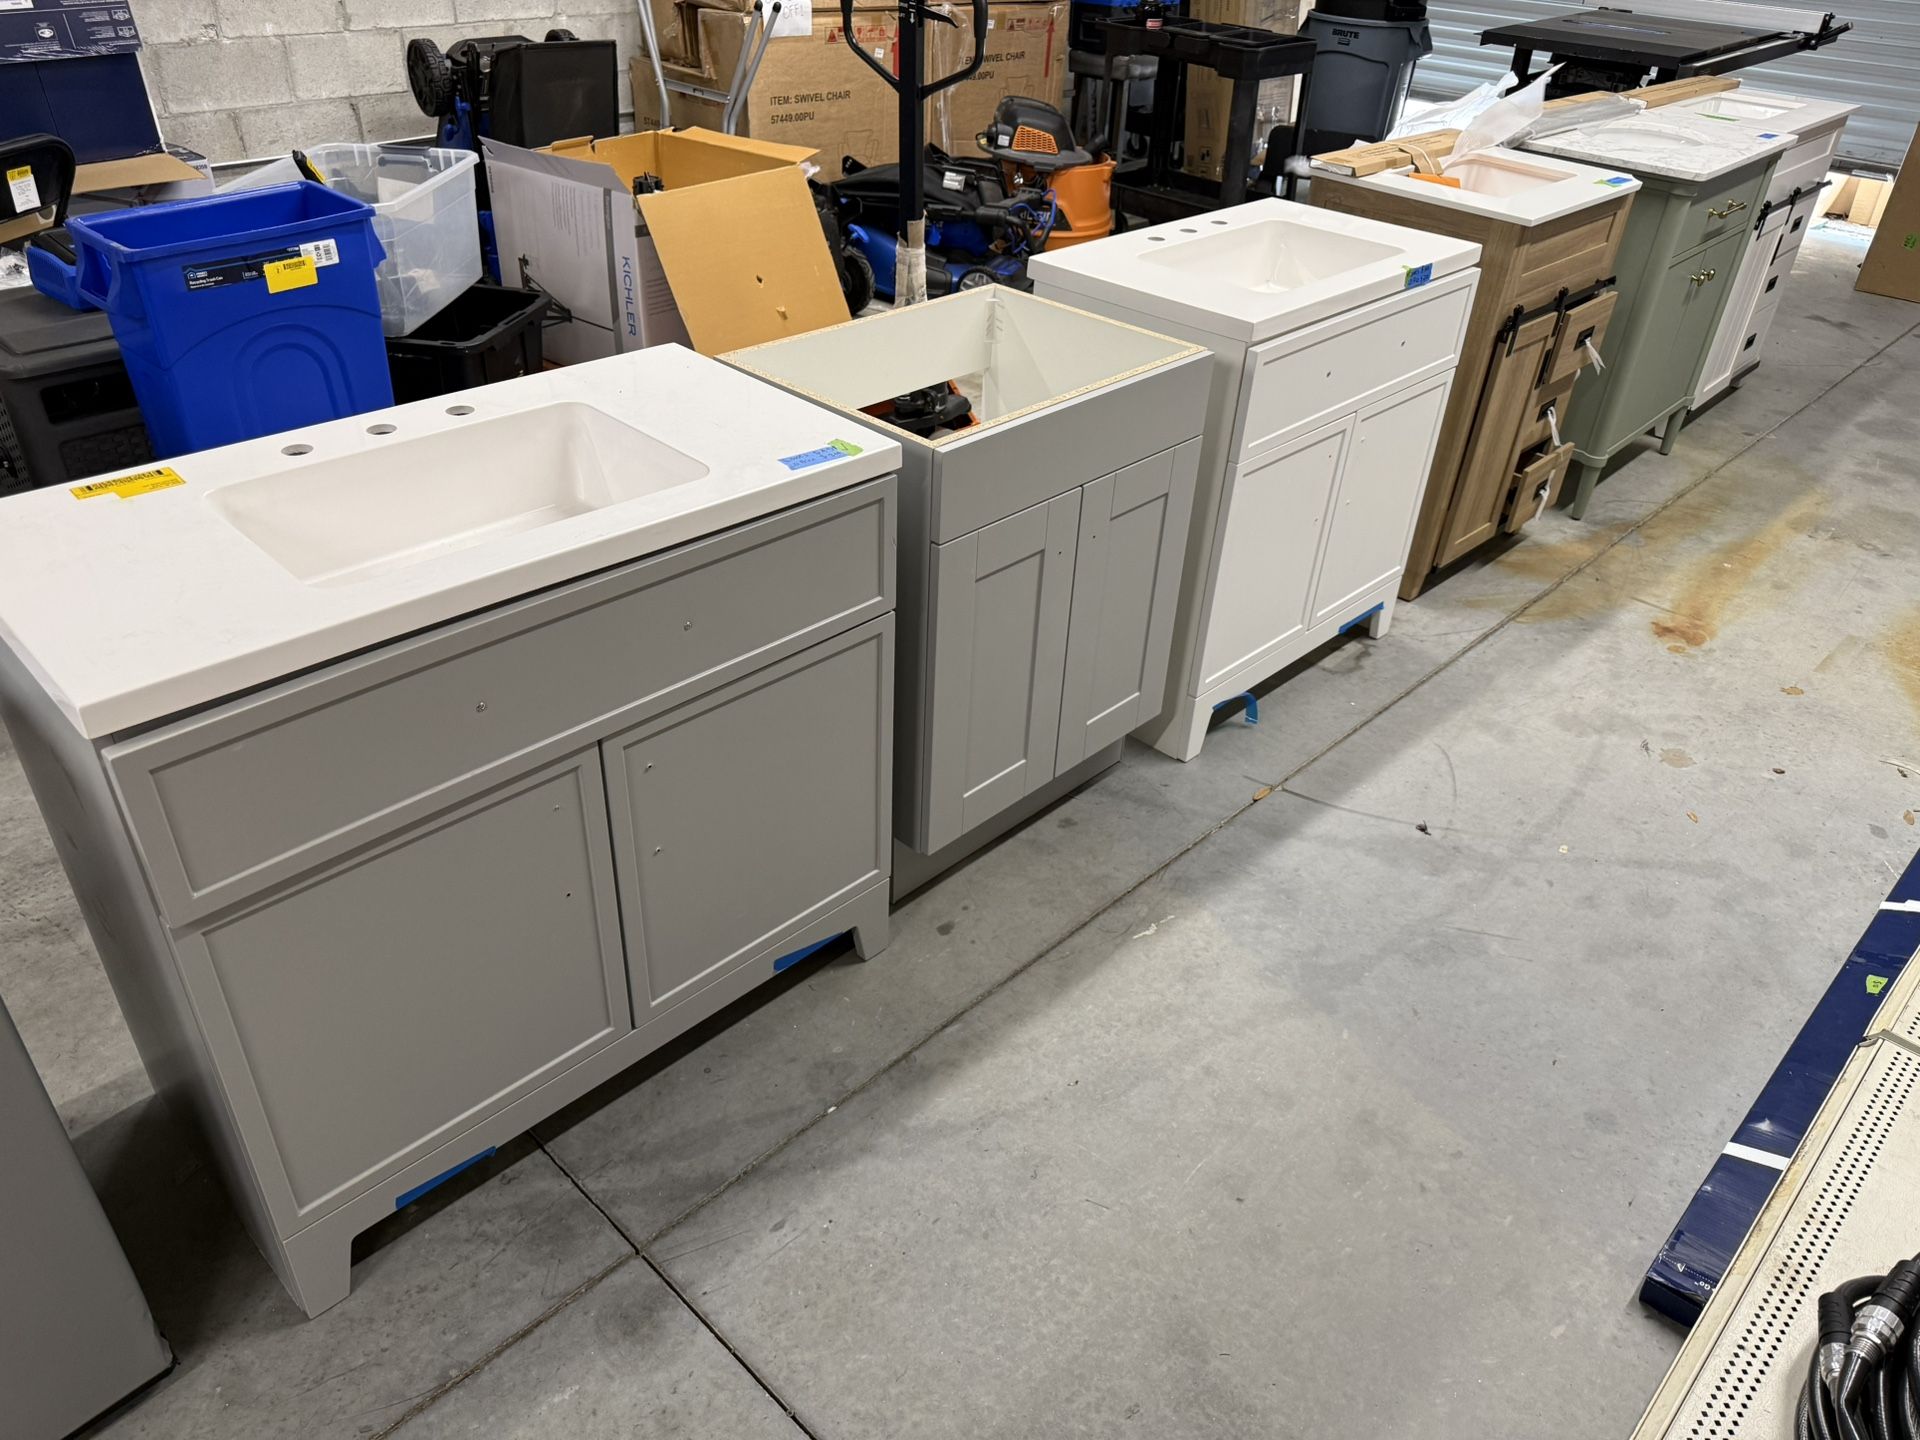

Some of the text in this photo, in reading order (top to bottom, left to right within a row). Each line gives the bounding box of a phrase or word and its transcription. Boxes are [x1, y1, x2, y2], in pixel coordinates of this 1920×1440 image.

[1332, 28, 1360, 39] BRUTE
[984, 53, 1004, 63] WIVEL
[1006, 51, 1025, 61] CHAIR
[770, 90, 851, 106] ITEM: SWIVEL CHAIR
[771, 112, 815, 124] 57449.00PU
[622, 256, 636, 336] KICHLER
